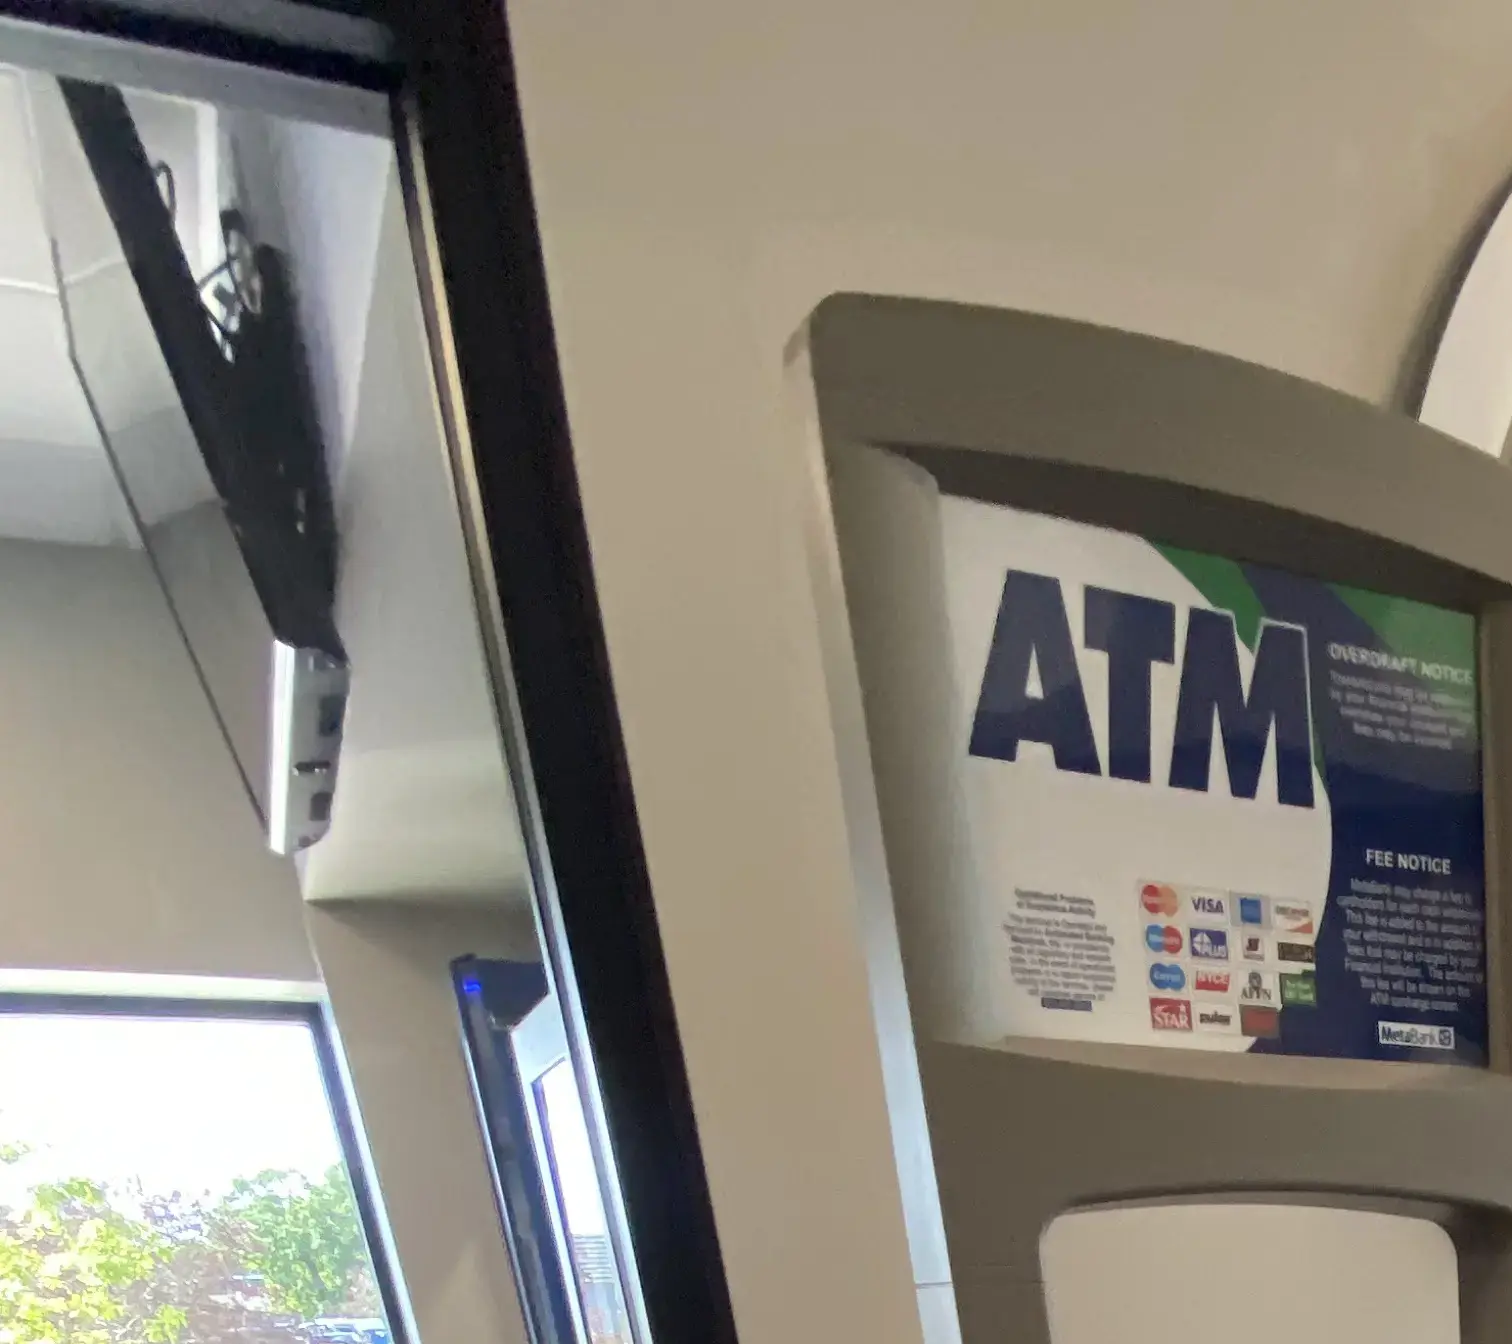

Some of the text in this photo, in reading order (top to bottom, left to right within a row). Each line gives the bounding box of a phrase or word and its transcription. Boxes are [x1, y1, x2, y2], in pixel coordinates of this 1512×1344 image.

[1420, 661, 1474, 685] NOTICE
[968, 568, 1315, 809] ATM
[1365, 849, 1452, 875] FEE NOTICE
[1191, 896, 1225, 914] VISA
[1153, 1009, 1190, 1029] STAR
